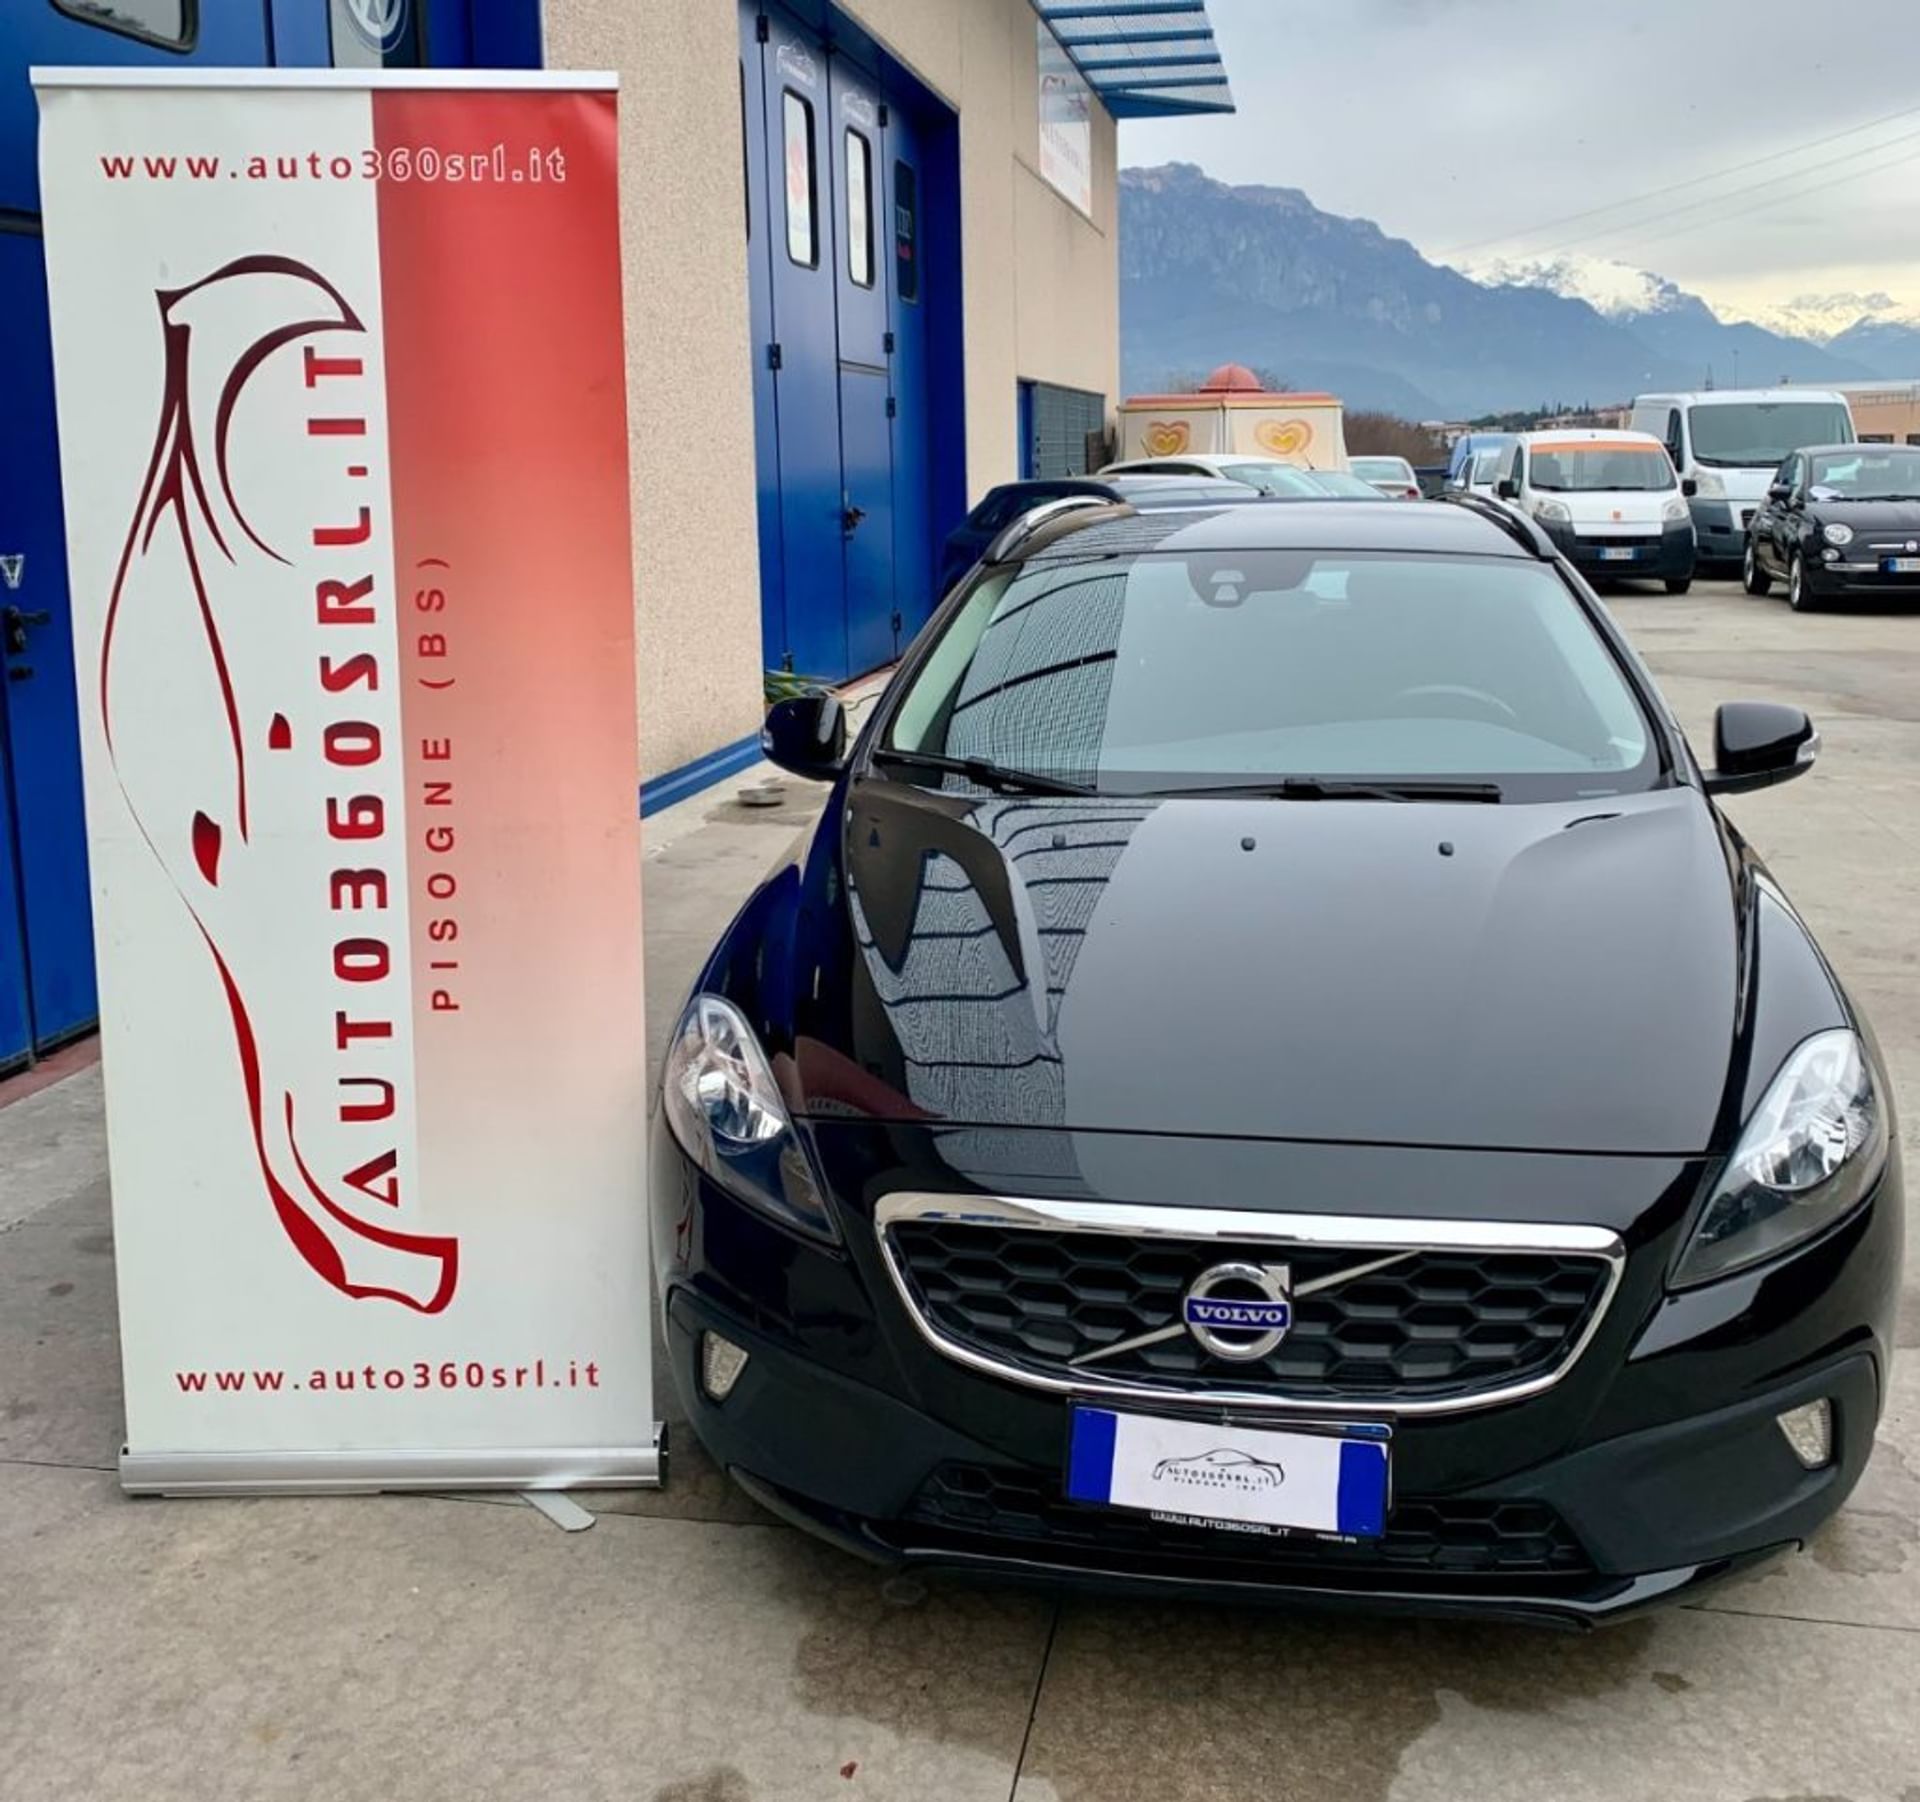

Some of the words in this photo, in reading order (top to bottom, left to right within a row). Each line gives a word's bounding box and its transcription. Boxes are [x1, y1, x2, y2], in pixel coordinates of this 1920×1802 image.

[102, 144, 568, 183] www.auto360srl.it
[415, 555, 456, 691] (BS)
[303, 345, 400, 1208] AUTO360SRL.IT
[422, 736, 461, 1012] PISOGNE
[1192, 1304, 1283, 1323] VOLVO
[176, 1361, 601, 1392] www.auto360srl.it
